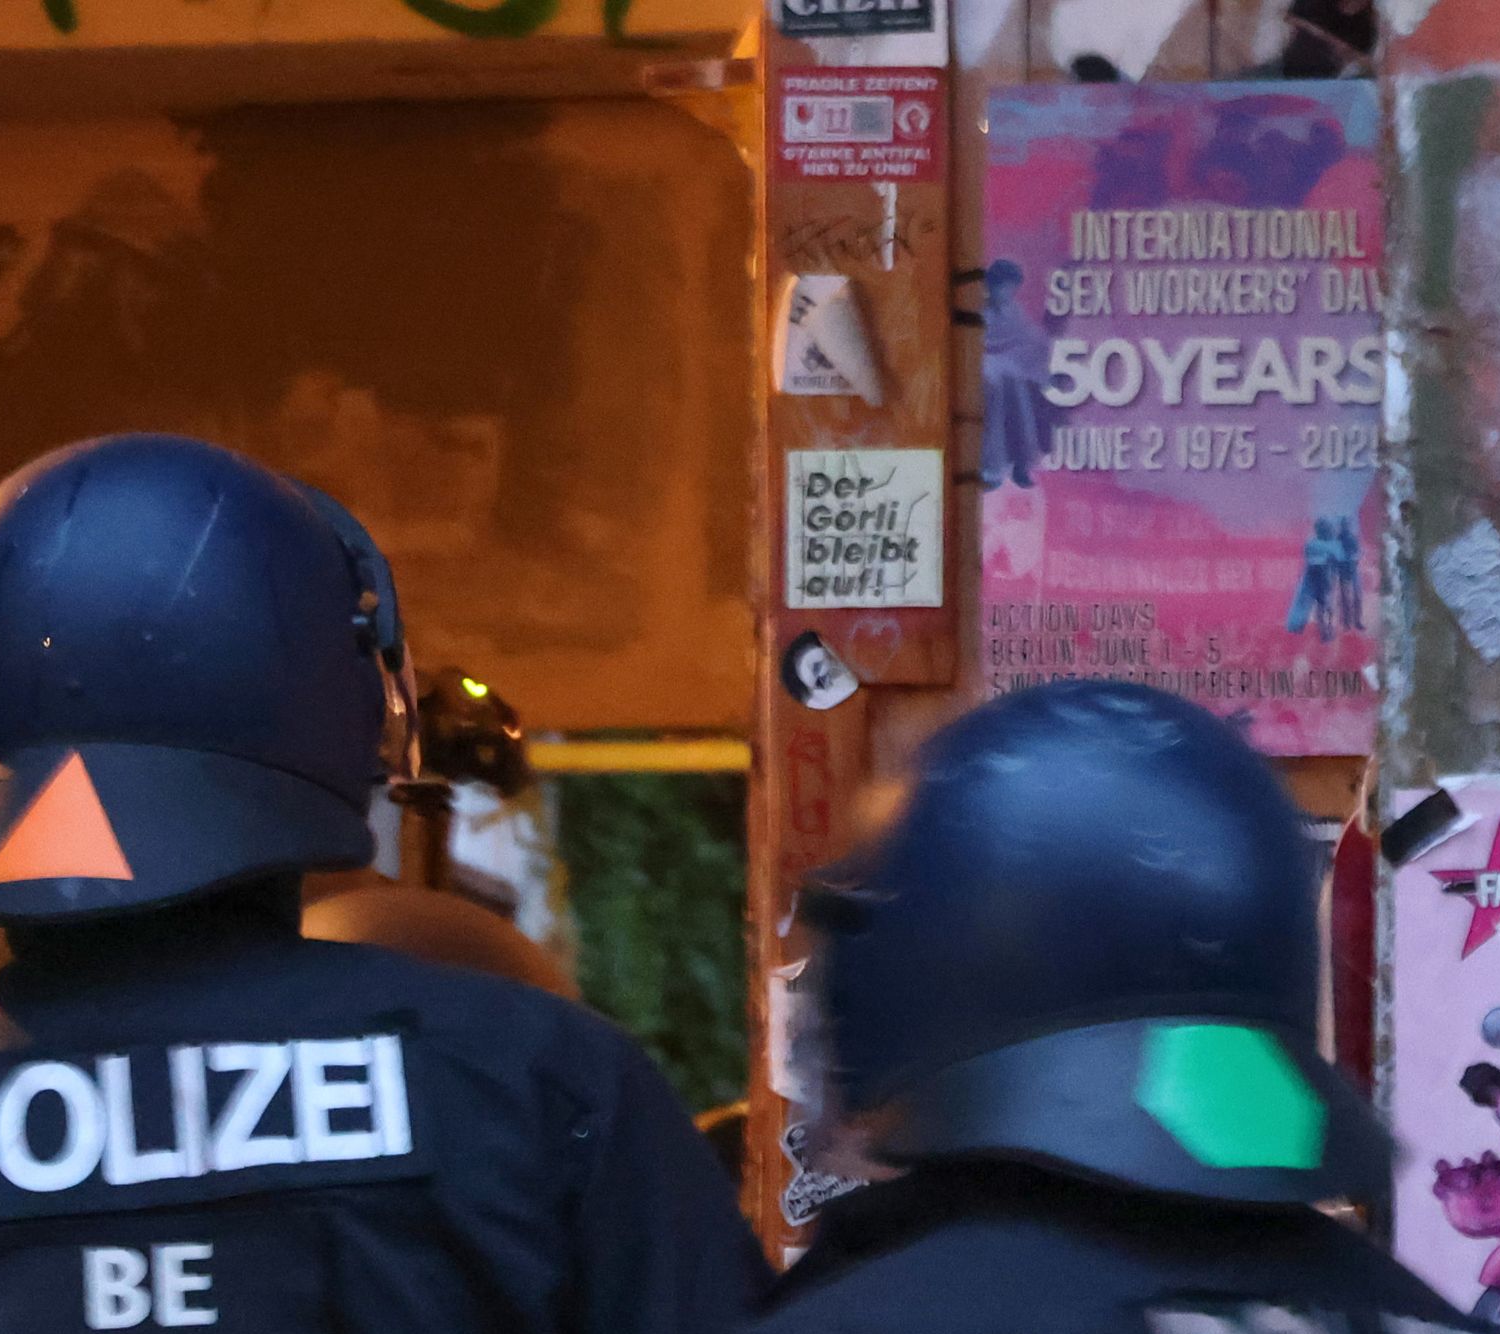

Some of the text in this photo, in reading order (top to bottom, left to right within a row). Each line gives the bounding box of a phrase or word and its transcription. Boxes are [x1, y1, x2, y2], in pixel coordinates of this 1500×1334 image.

[1070, 209, 1366, 262] INTERNATIONAL
[1048, 269, 1112, 317] SEX
[1042, 425, 1131, 472] JUNE
[1143, 425, 1165, 470] 2
[1174, 425, 1257, 470] 1975
[807, 472, 874, 498] Der
[807, 501, 900, 532] Görli
[807, 533, 920, 565] bleibt
[807, 568, 884, 597] auf!
[991, 602, 1156, 633] ACTION DAYS
[990, 637, 1077, 667] BERLIN
[1088, 637, 1152, 666] JUNE
[1206, 636, 1223, 665] 5
[81, 1243, 218, 1333] BE
